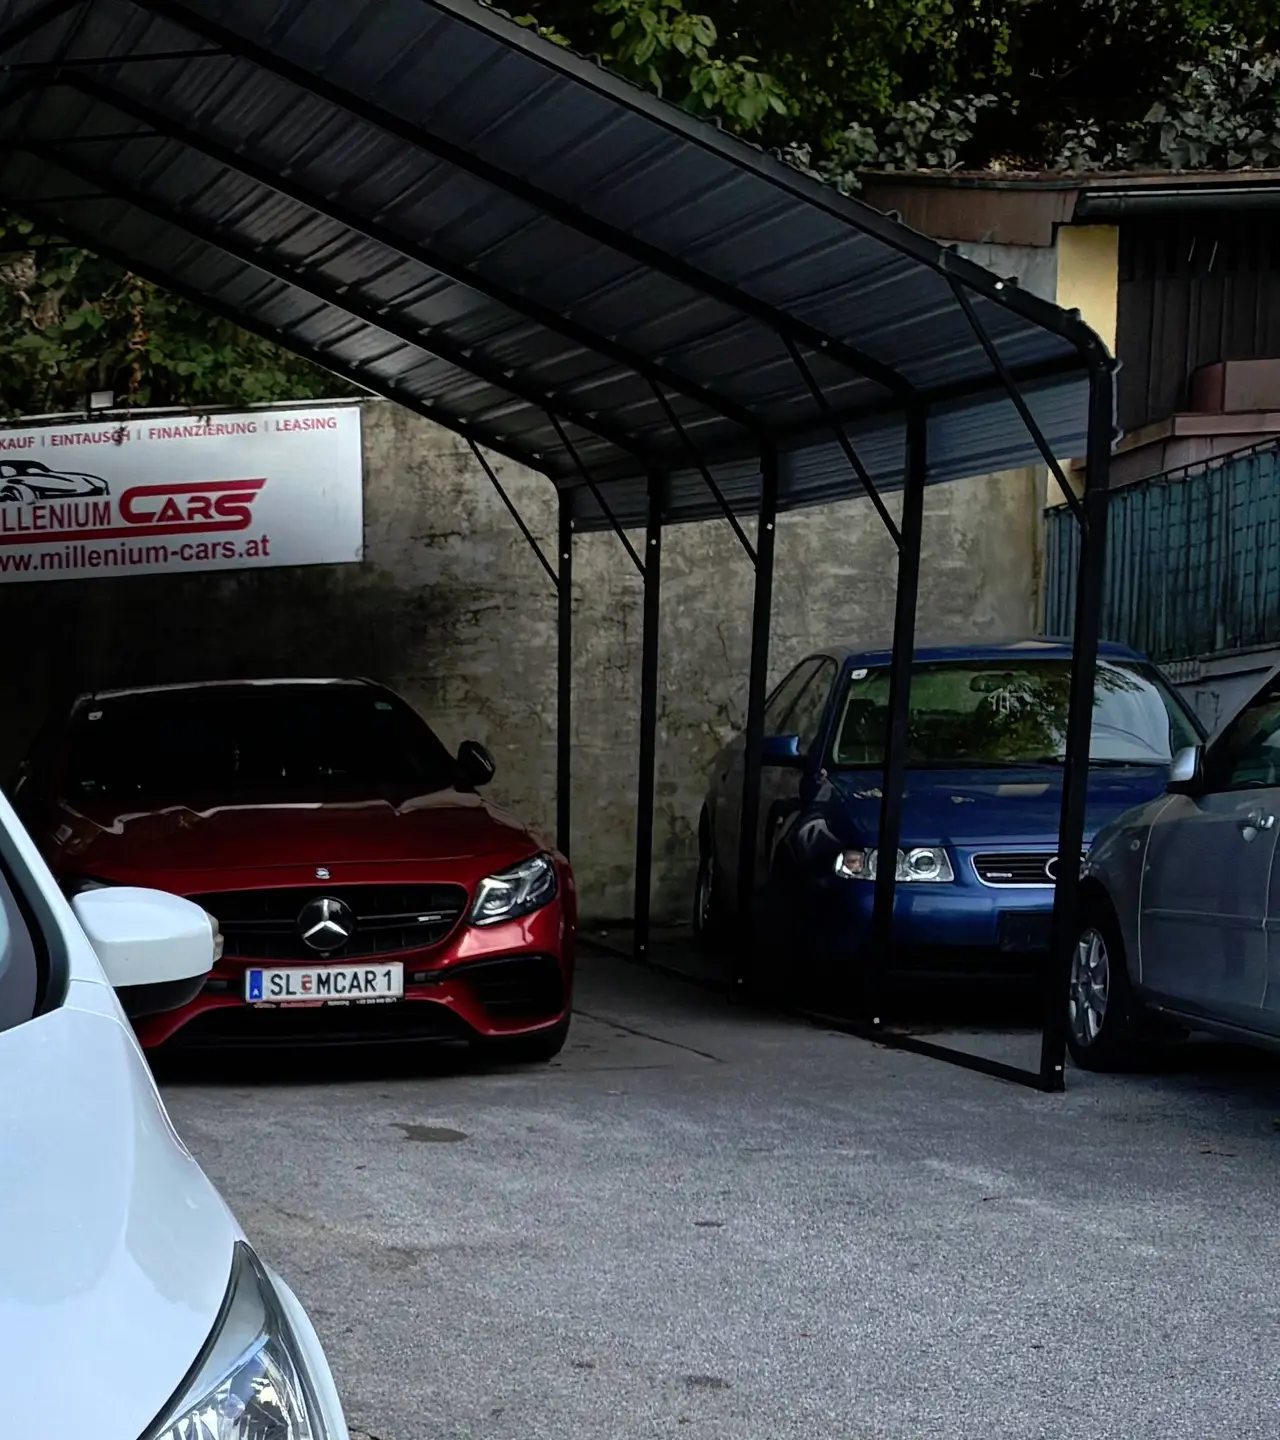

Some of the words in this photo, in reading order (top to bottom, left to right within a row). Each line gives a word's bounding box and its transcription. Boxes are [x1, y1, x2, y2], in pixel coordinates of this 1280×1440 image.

[148, 421, 257, 440] FINANZIERUNG
[276, 417, 337, 432] LEASING
[119, 478, 268, 531] CARS
[270, 973, 297, 996] SL
[317, 970, 377, 995] MCAR
